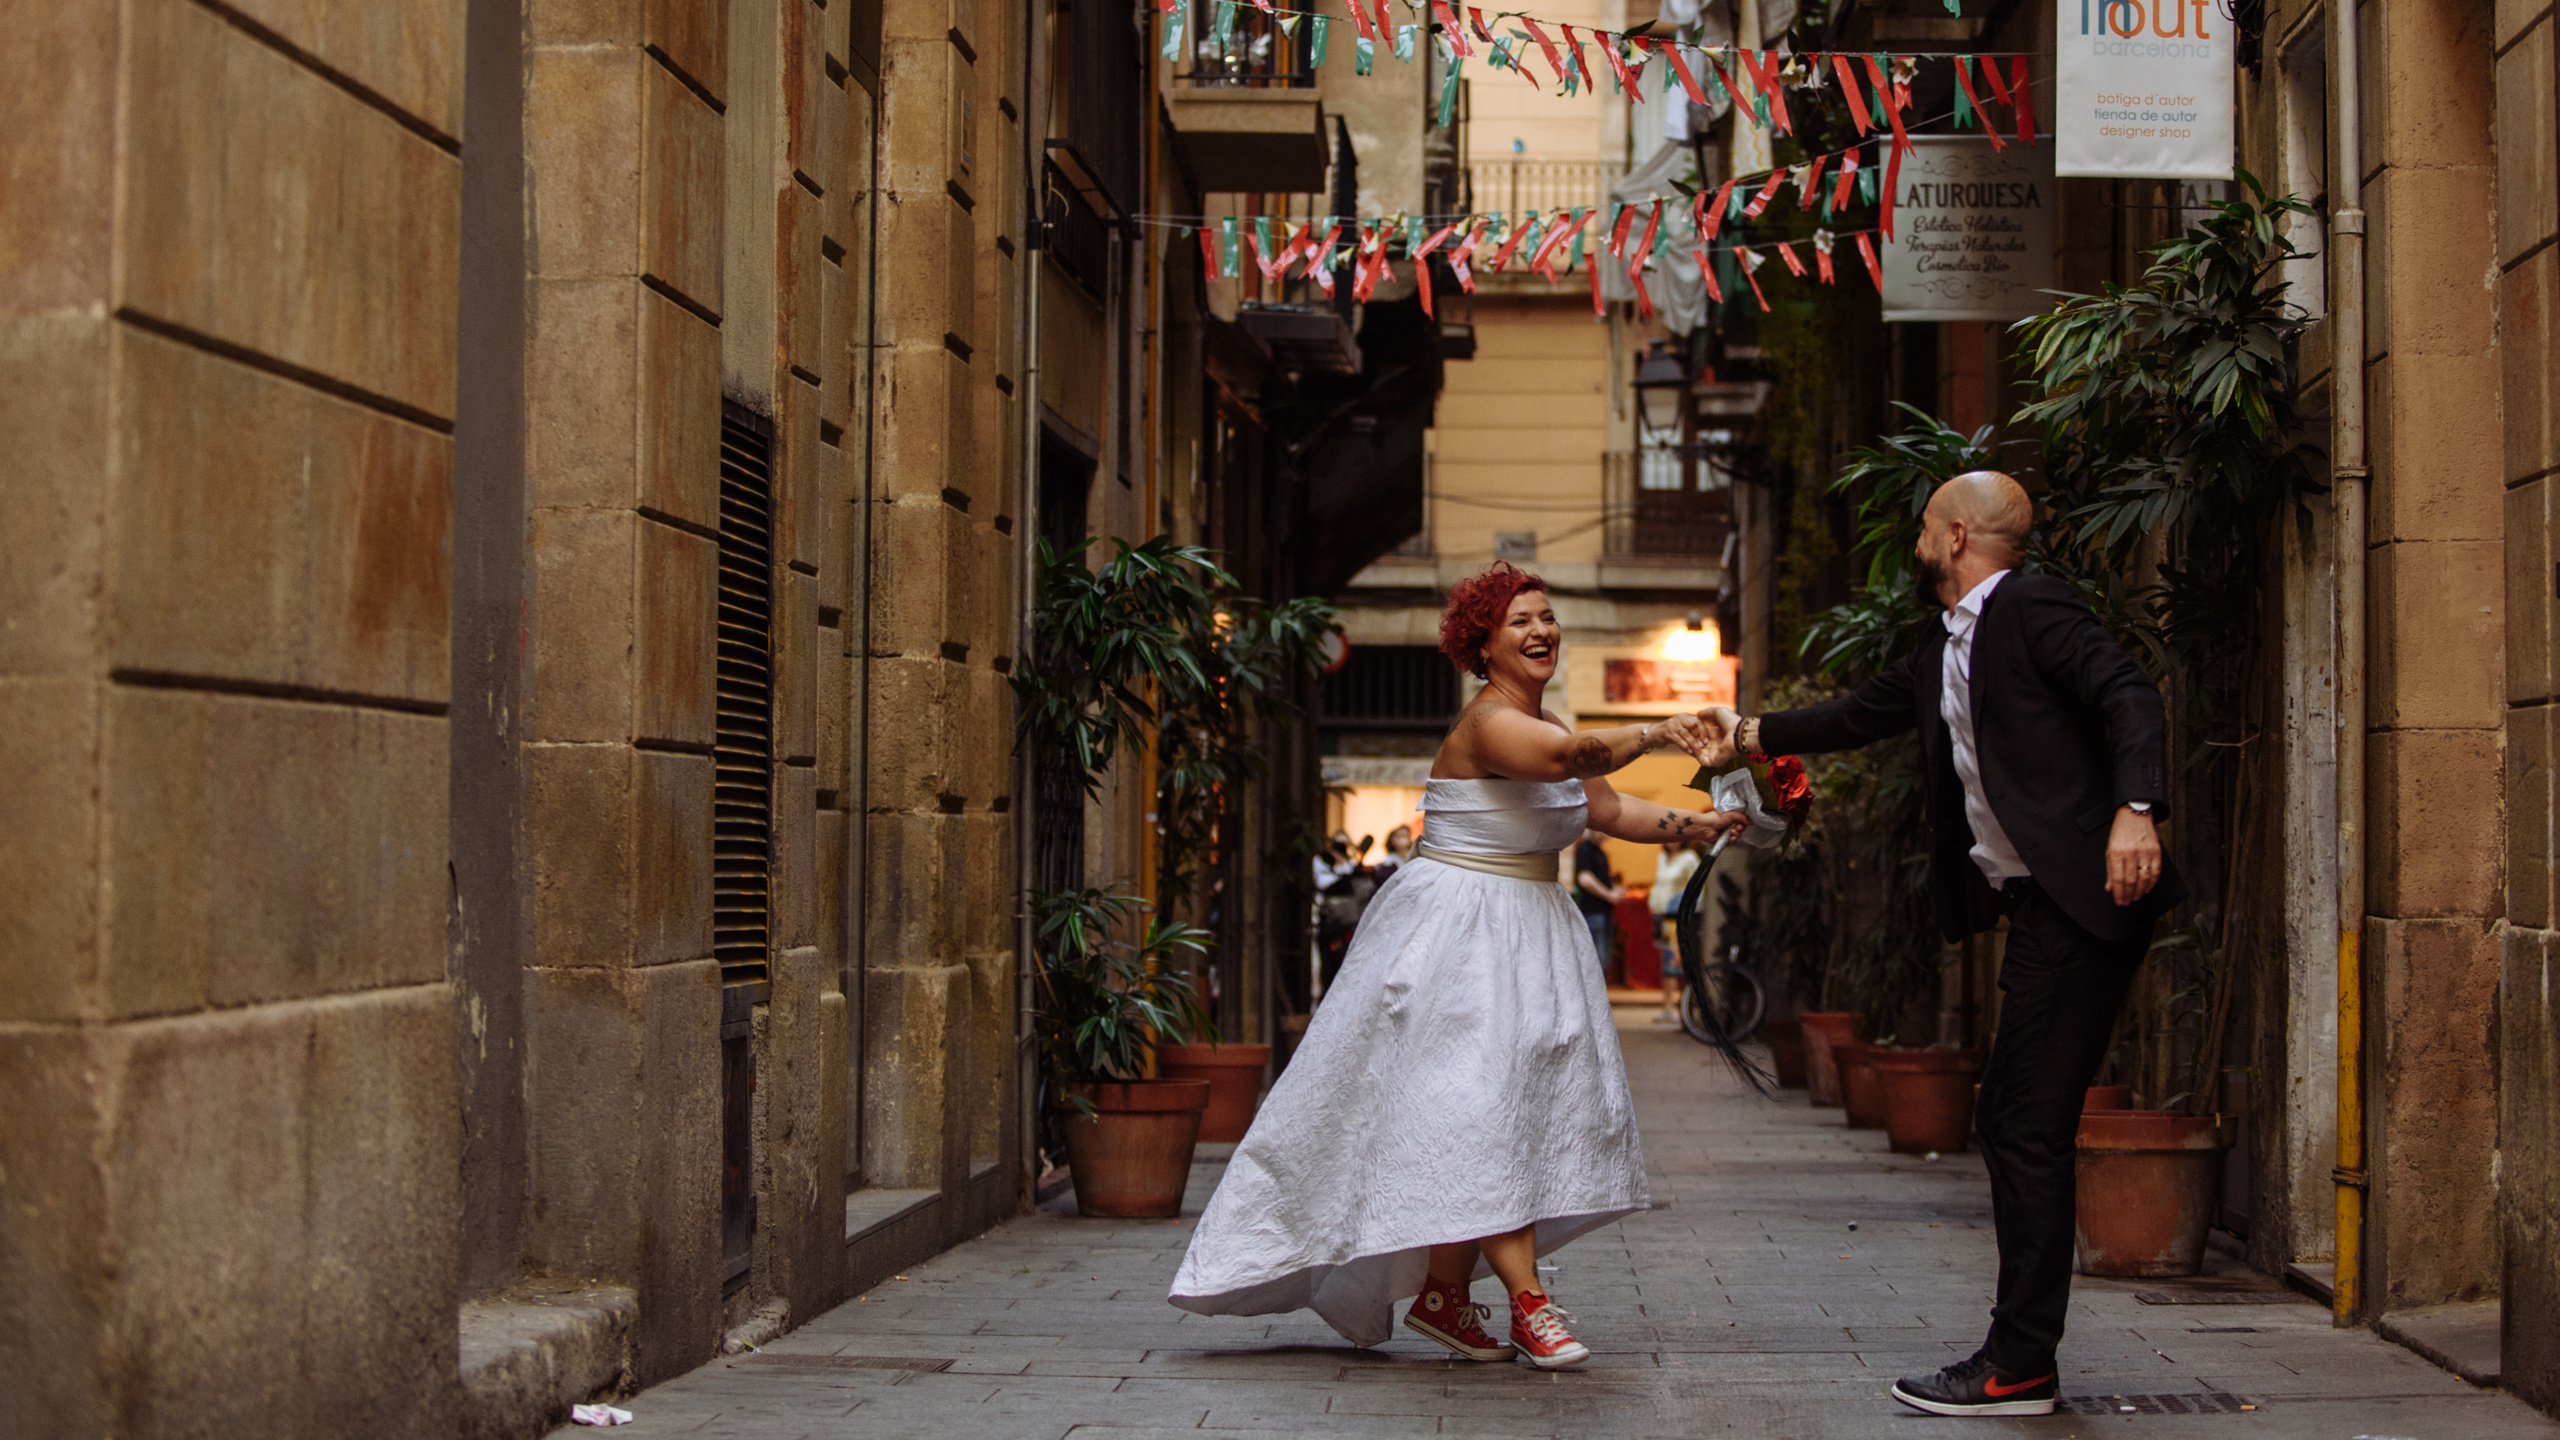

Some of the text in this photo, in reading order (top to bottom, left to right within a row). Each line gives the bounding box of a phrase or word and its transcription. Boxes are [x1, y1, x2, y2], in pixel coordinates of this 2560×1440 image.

[2092, 37, 2211, 59] barcelona
[2097, 92, 2141, 107] botiga
[2094, 109, 2198, 122] tienda de autor
[2100, 125, 2191, 140] designer shop
[1906, 235, 2026, 256] Terapias Naturales
[1983, 254, 2010, 273] Bio
